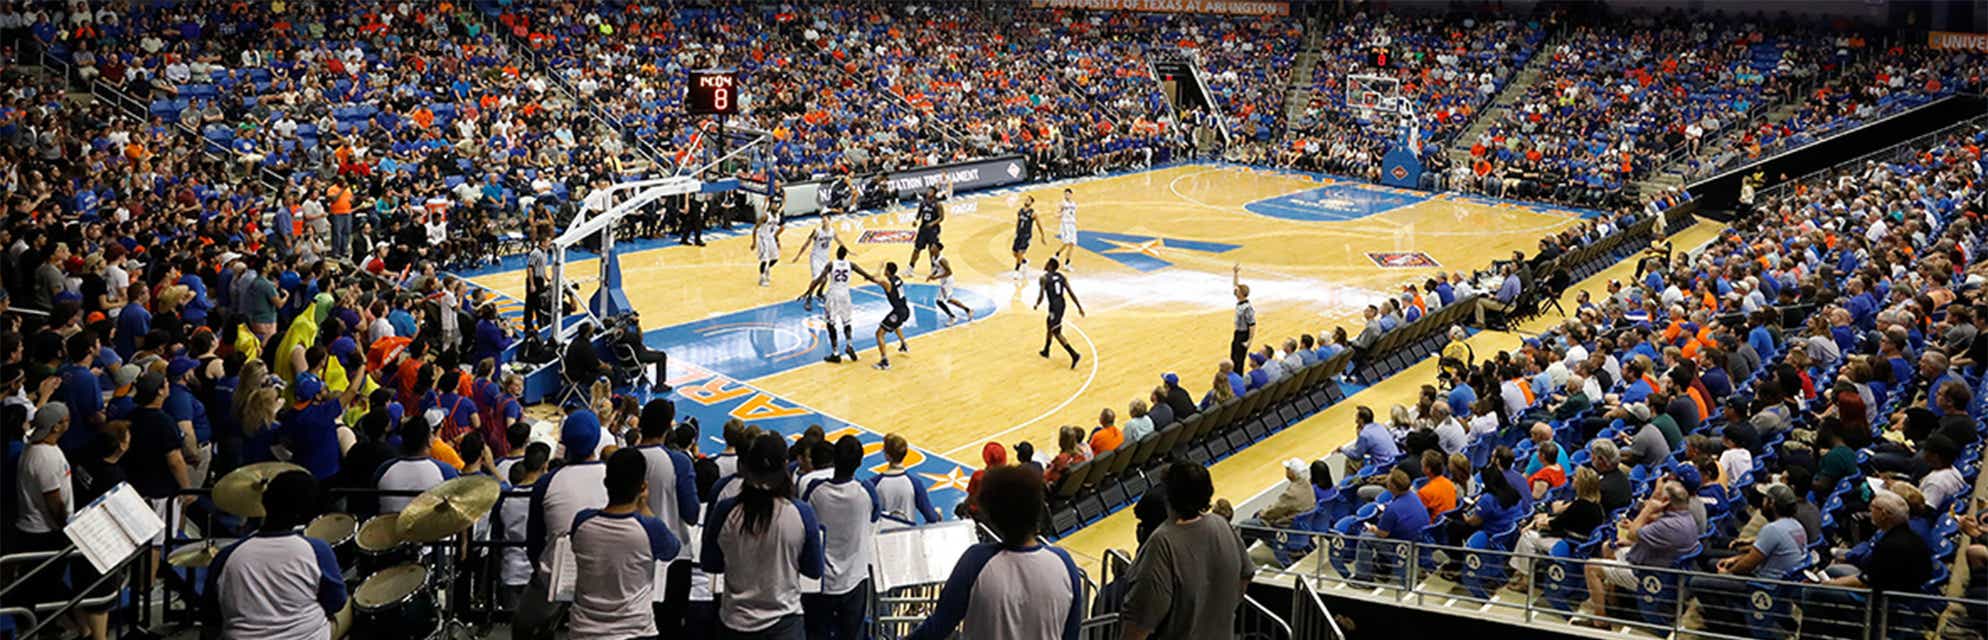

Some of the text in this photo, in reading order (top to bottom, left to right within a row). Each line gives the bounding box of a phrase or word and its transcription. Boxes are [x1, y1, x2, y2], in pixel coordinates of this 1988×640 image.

[1144, 0, 1181, 10] TEXAS
[1186, 1, 1202, 12] AT
[1204, 2, 1278, 15] ARLINGTON
[715, 88, 728, 110] 8
[834, 269, 849, 282] 25
